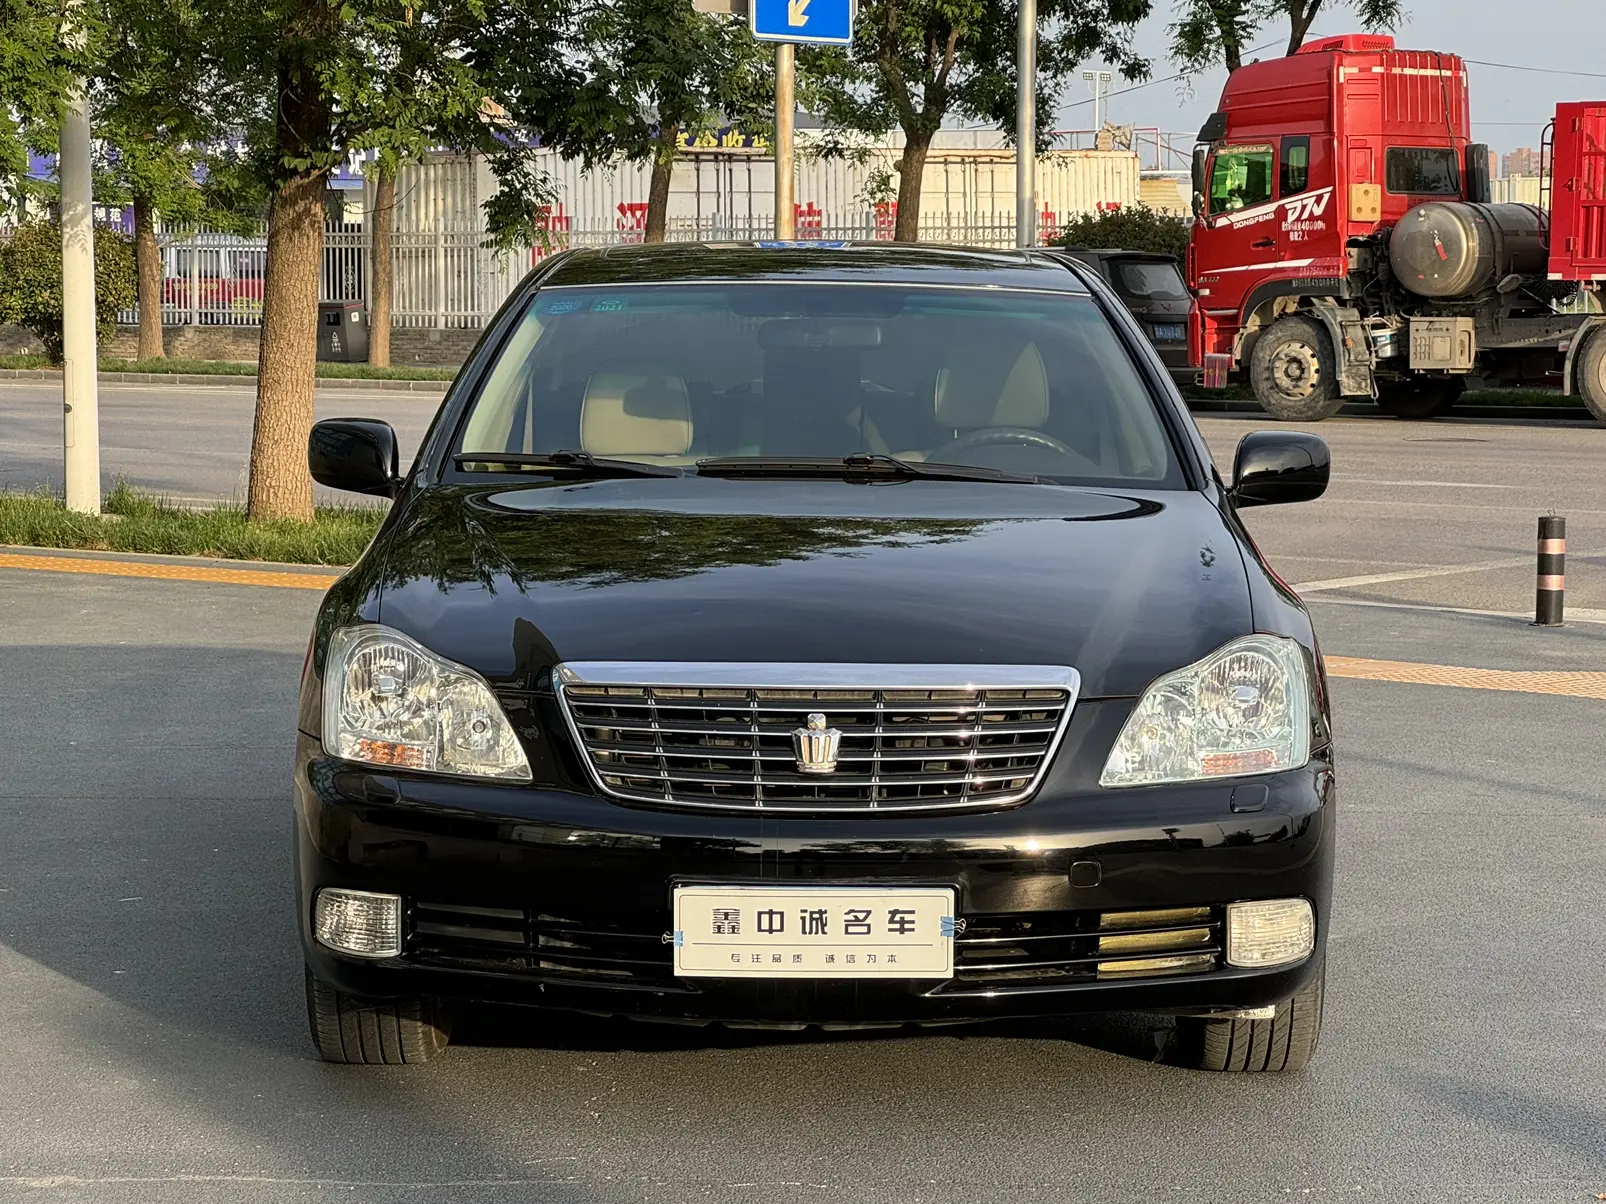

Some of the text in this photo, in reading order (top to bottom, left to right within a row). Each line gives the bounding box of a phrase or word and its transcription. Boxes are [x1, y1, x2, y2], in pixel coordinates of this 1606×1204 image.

[1233, 212, 1275, 229] DONGFENG
[711, 908, 916, 936] 鑫中诚名车
[730, 953, 898, 964] 专注品质 诚信为本
